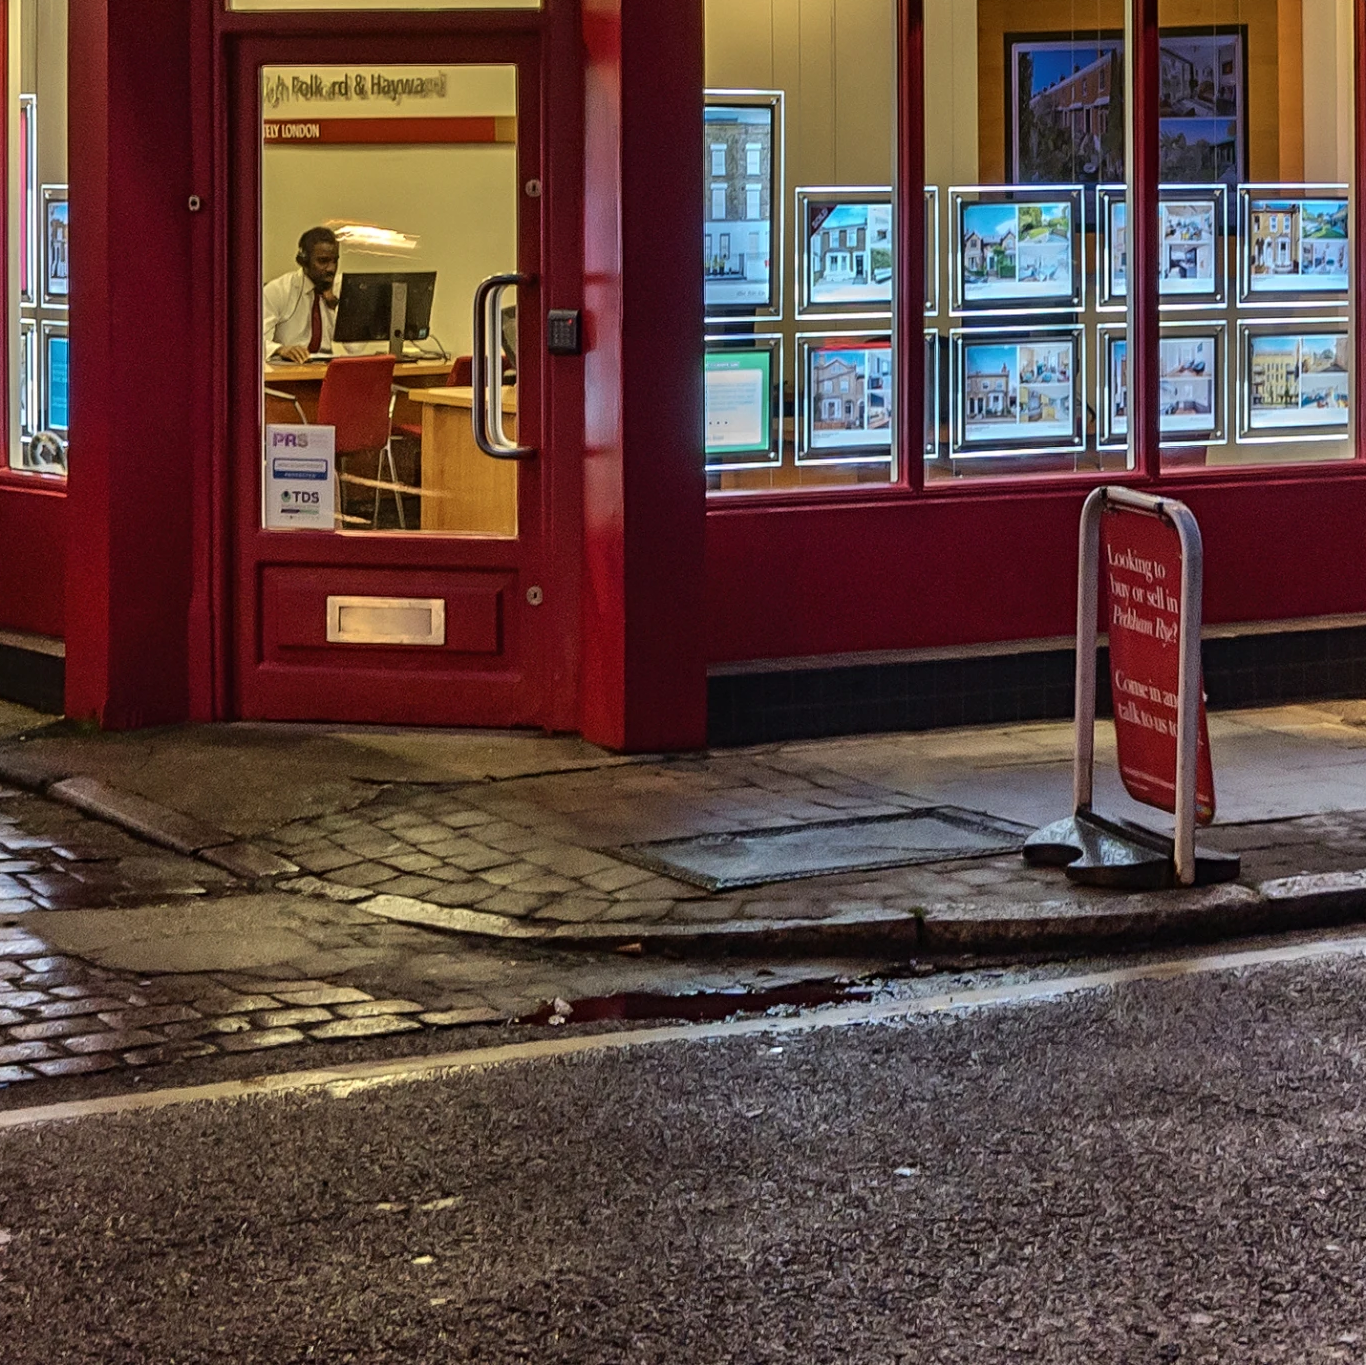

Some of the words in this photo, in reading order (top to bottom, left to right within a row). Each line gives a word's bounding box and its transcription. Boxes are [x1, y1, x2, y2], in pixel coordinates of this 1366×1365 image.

[281, 123, 320, 138] LONDON
[292, 490, 320, 504] TDS
[1108, 544, 1153, 583] Looking
[1154, 560, 1166, 579] to
[1110, 573, 1130, 606] buy
[1132, 585, 1144, 604] or
[1146, 586, 1165, 609] sell
[1166, 589, 1179, 614] in
[1113, 604, 1154, 637] Peckham
[1155, 617, 1178, 648] Rye?
[1115, 669, 1149, 699] Come
[1149, 679, 1161, 704] in
[1117, 701, 1141, 725] talk
[1141, 711, 1153, 729] to
[1154, 718, 1168, 735] us
